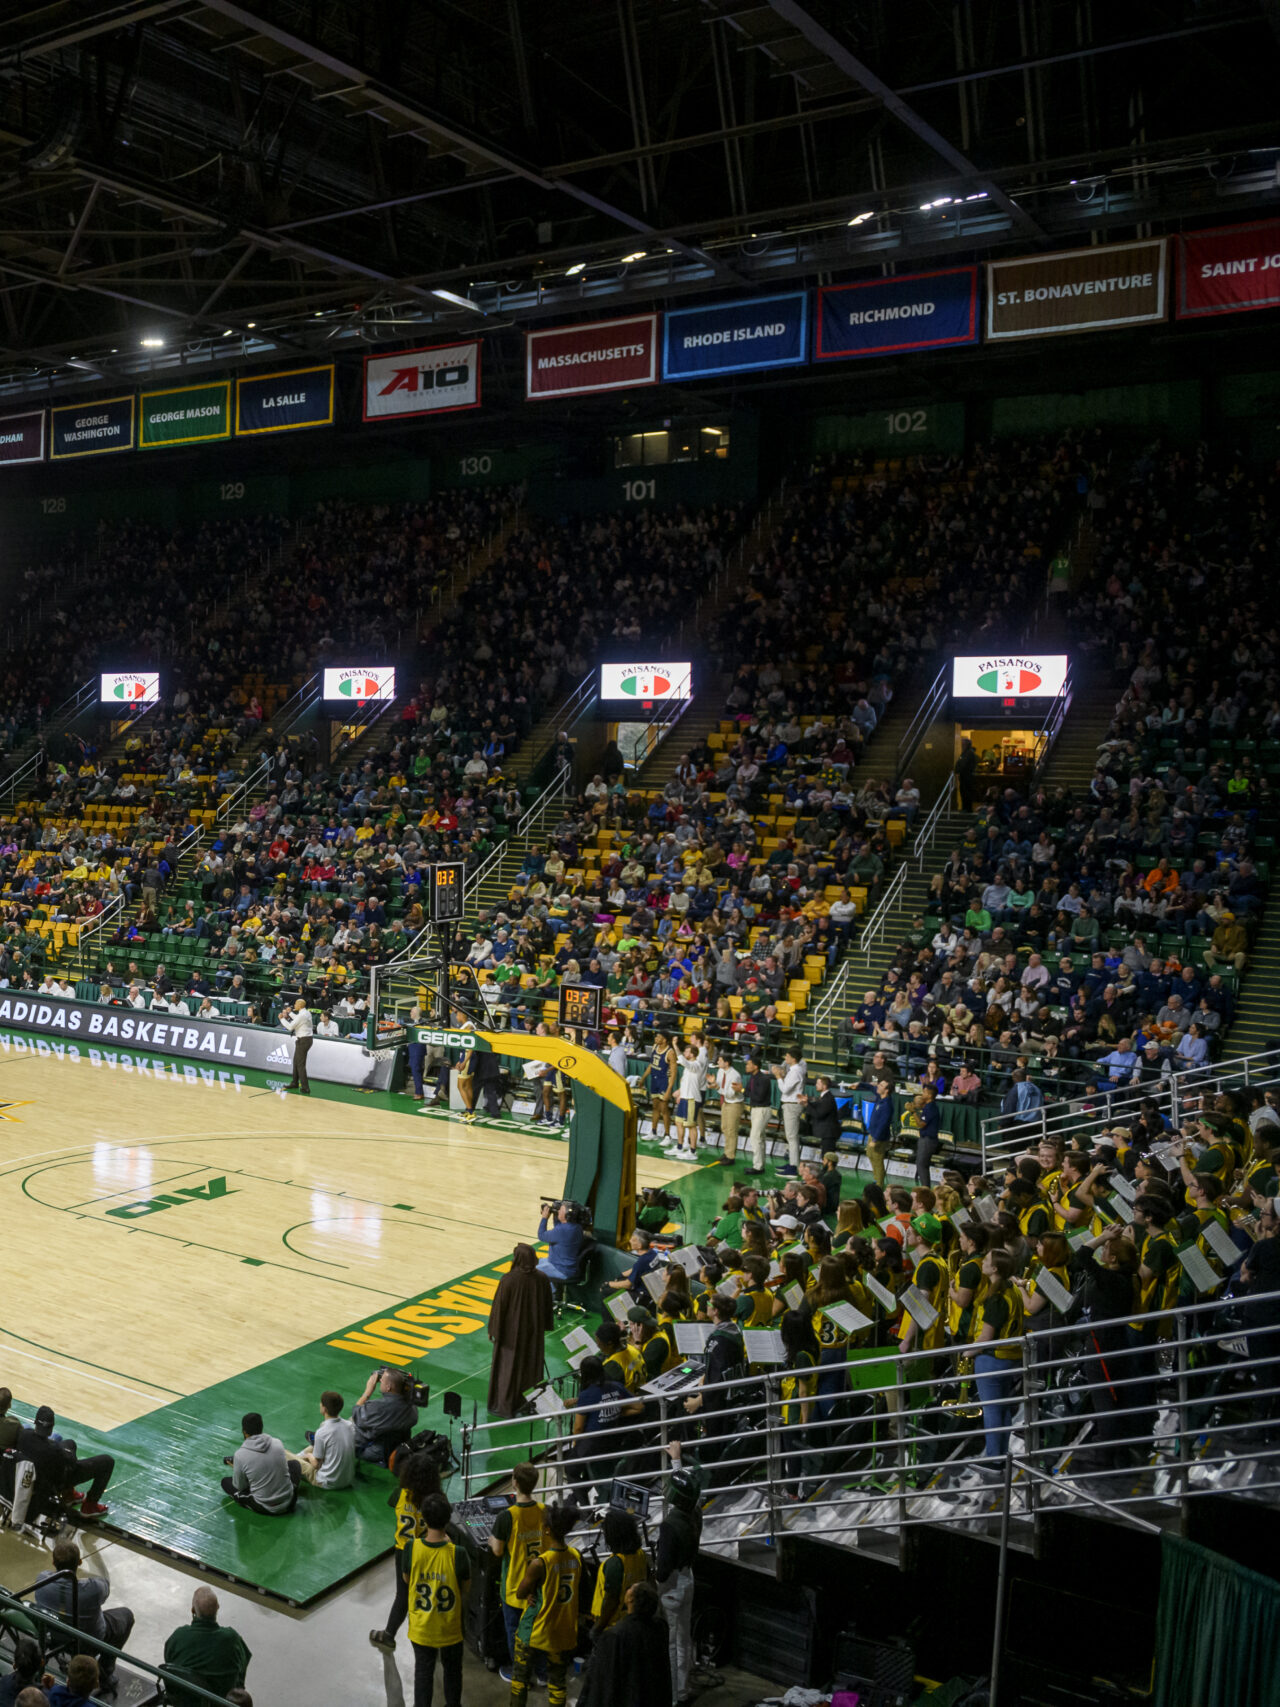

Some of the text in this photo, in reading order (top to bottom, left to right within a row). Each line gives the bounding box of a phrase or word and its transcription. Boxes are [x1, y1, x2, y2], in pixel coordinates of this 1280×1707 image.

[1200, 256, 1258, 279] SAINT
[997, 273, 1154, 306] ST. BONAVENTURE
[849, 302, 936, 326] RICHMOND
[683, 323, 786, 349] RHODE ISLAND
[537, 343, 645, 370] MASSACHUSETTS
[262, 393, 306, 409] LA SALLE
[75, 414, 109, 429] GEORGE
[149, 405, 221, 424] GEORGE MASON
[884, 410, 928, 434] 102
[64, 425, 120, 443] WASHINGTON
[460, 456, 492, 476] 130
[220, 482, 246, 500] 129
[623, 479, 656, 501] 101
[40, 498, 67, 514] 128
[338, 669, 380, 681] PAISANO'S
[621, 665, 672, 679] PAISANO'S
[978, 658, 1042, 673] PAISANO'S
[88, 1015, 247, 1058] BASKETBALL
[266, 1055, 292, 1065] adidas
[417, 1030, 476, 1049] GEICO
[415, 1583, 456, 1613] 39
